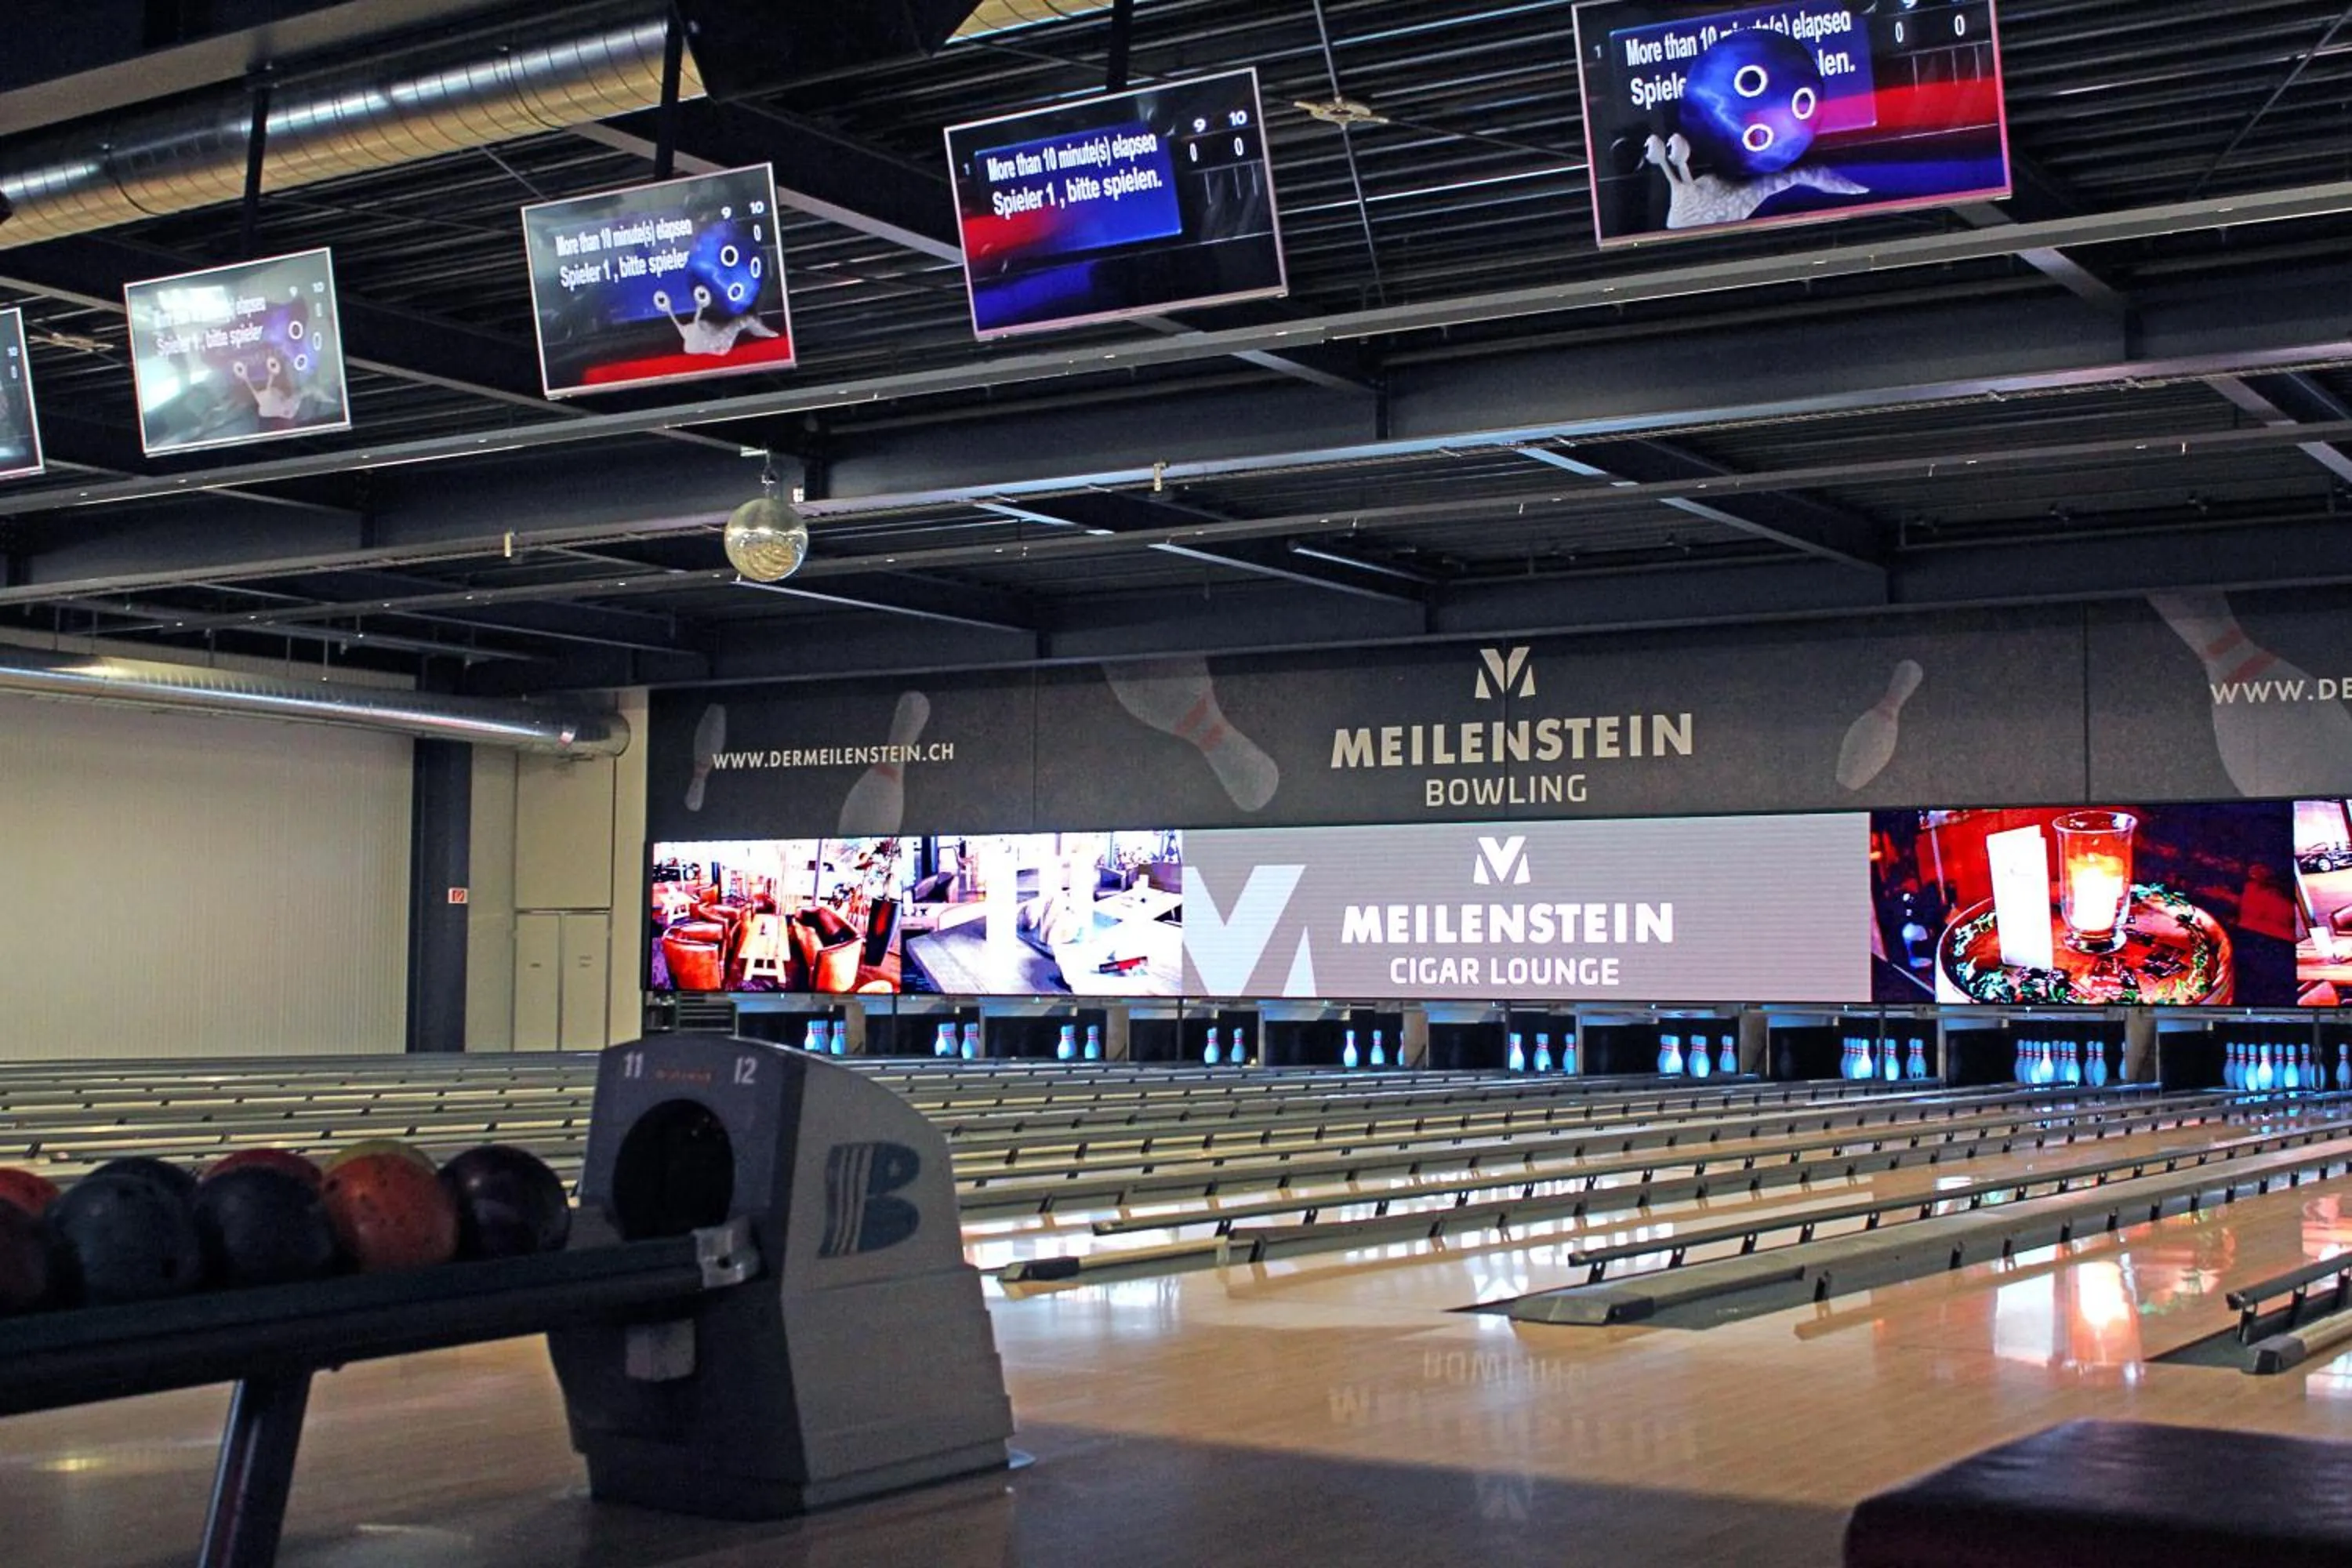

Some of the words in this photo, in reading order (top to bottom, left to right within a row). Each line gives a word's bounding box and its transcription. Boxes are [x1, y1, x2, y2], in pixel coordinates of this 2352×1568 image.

[1625, 36, 1662, 67] More
[1664, 32, 1697, 60] than
[1792, 10, 1852, 43] elapsed
[1895, 21, 1904, 43] 0
[1955, 14, 1965, 36] 0
[1193, 118, 1206, 132] 9
[1229, 110, 1247, 126] 10
[987, 158, 1016, 183] More
[1016, 151, 1042, 176] than
[1043, 147, 1057, 172] 10
[1058, 136, 1111, 168] minute(s)
[1189, 143, 1197, 162] 0
[1234, 137, 1243, 156] 0
[721, 206, 731, 219] 9
[750, 201, 764, 214] 10
[993, 187, 1044, 220] Spieler
[1046, 182, 1056, 206] 1
[1066, 175, 1101, 204] bitte
[1102, 167, 1163, 201] spielen.
[555, 235, 579, 257] More
[579, 232, 601, 253] than
[612, 218, 655, 248] minute(s)
[753, 224, 762, 241] 0
[560, 261, 601, 292] Spieler
[603, 259, 611, 280] 1
[619, 255, 647, 278] bitte
[712, 742, 955, 770] WWW.DERMEILENSTEIN.CH
[1330, 713, 1693, 768] MEILENSTEIN
[1425, 774, 1588, 808] BOWLING
[1341, 902, 1674, 944] MEILENSTEIN
[1390, 957, 1481, 993] CIGAR
[1490, 958, 1620, 993] LOUNGE
[623, 1051, 644, 1079] 11
[735, 1056, 757, 1084] 12
